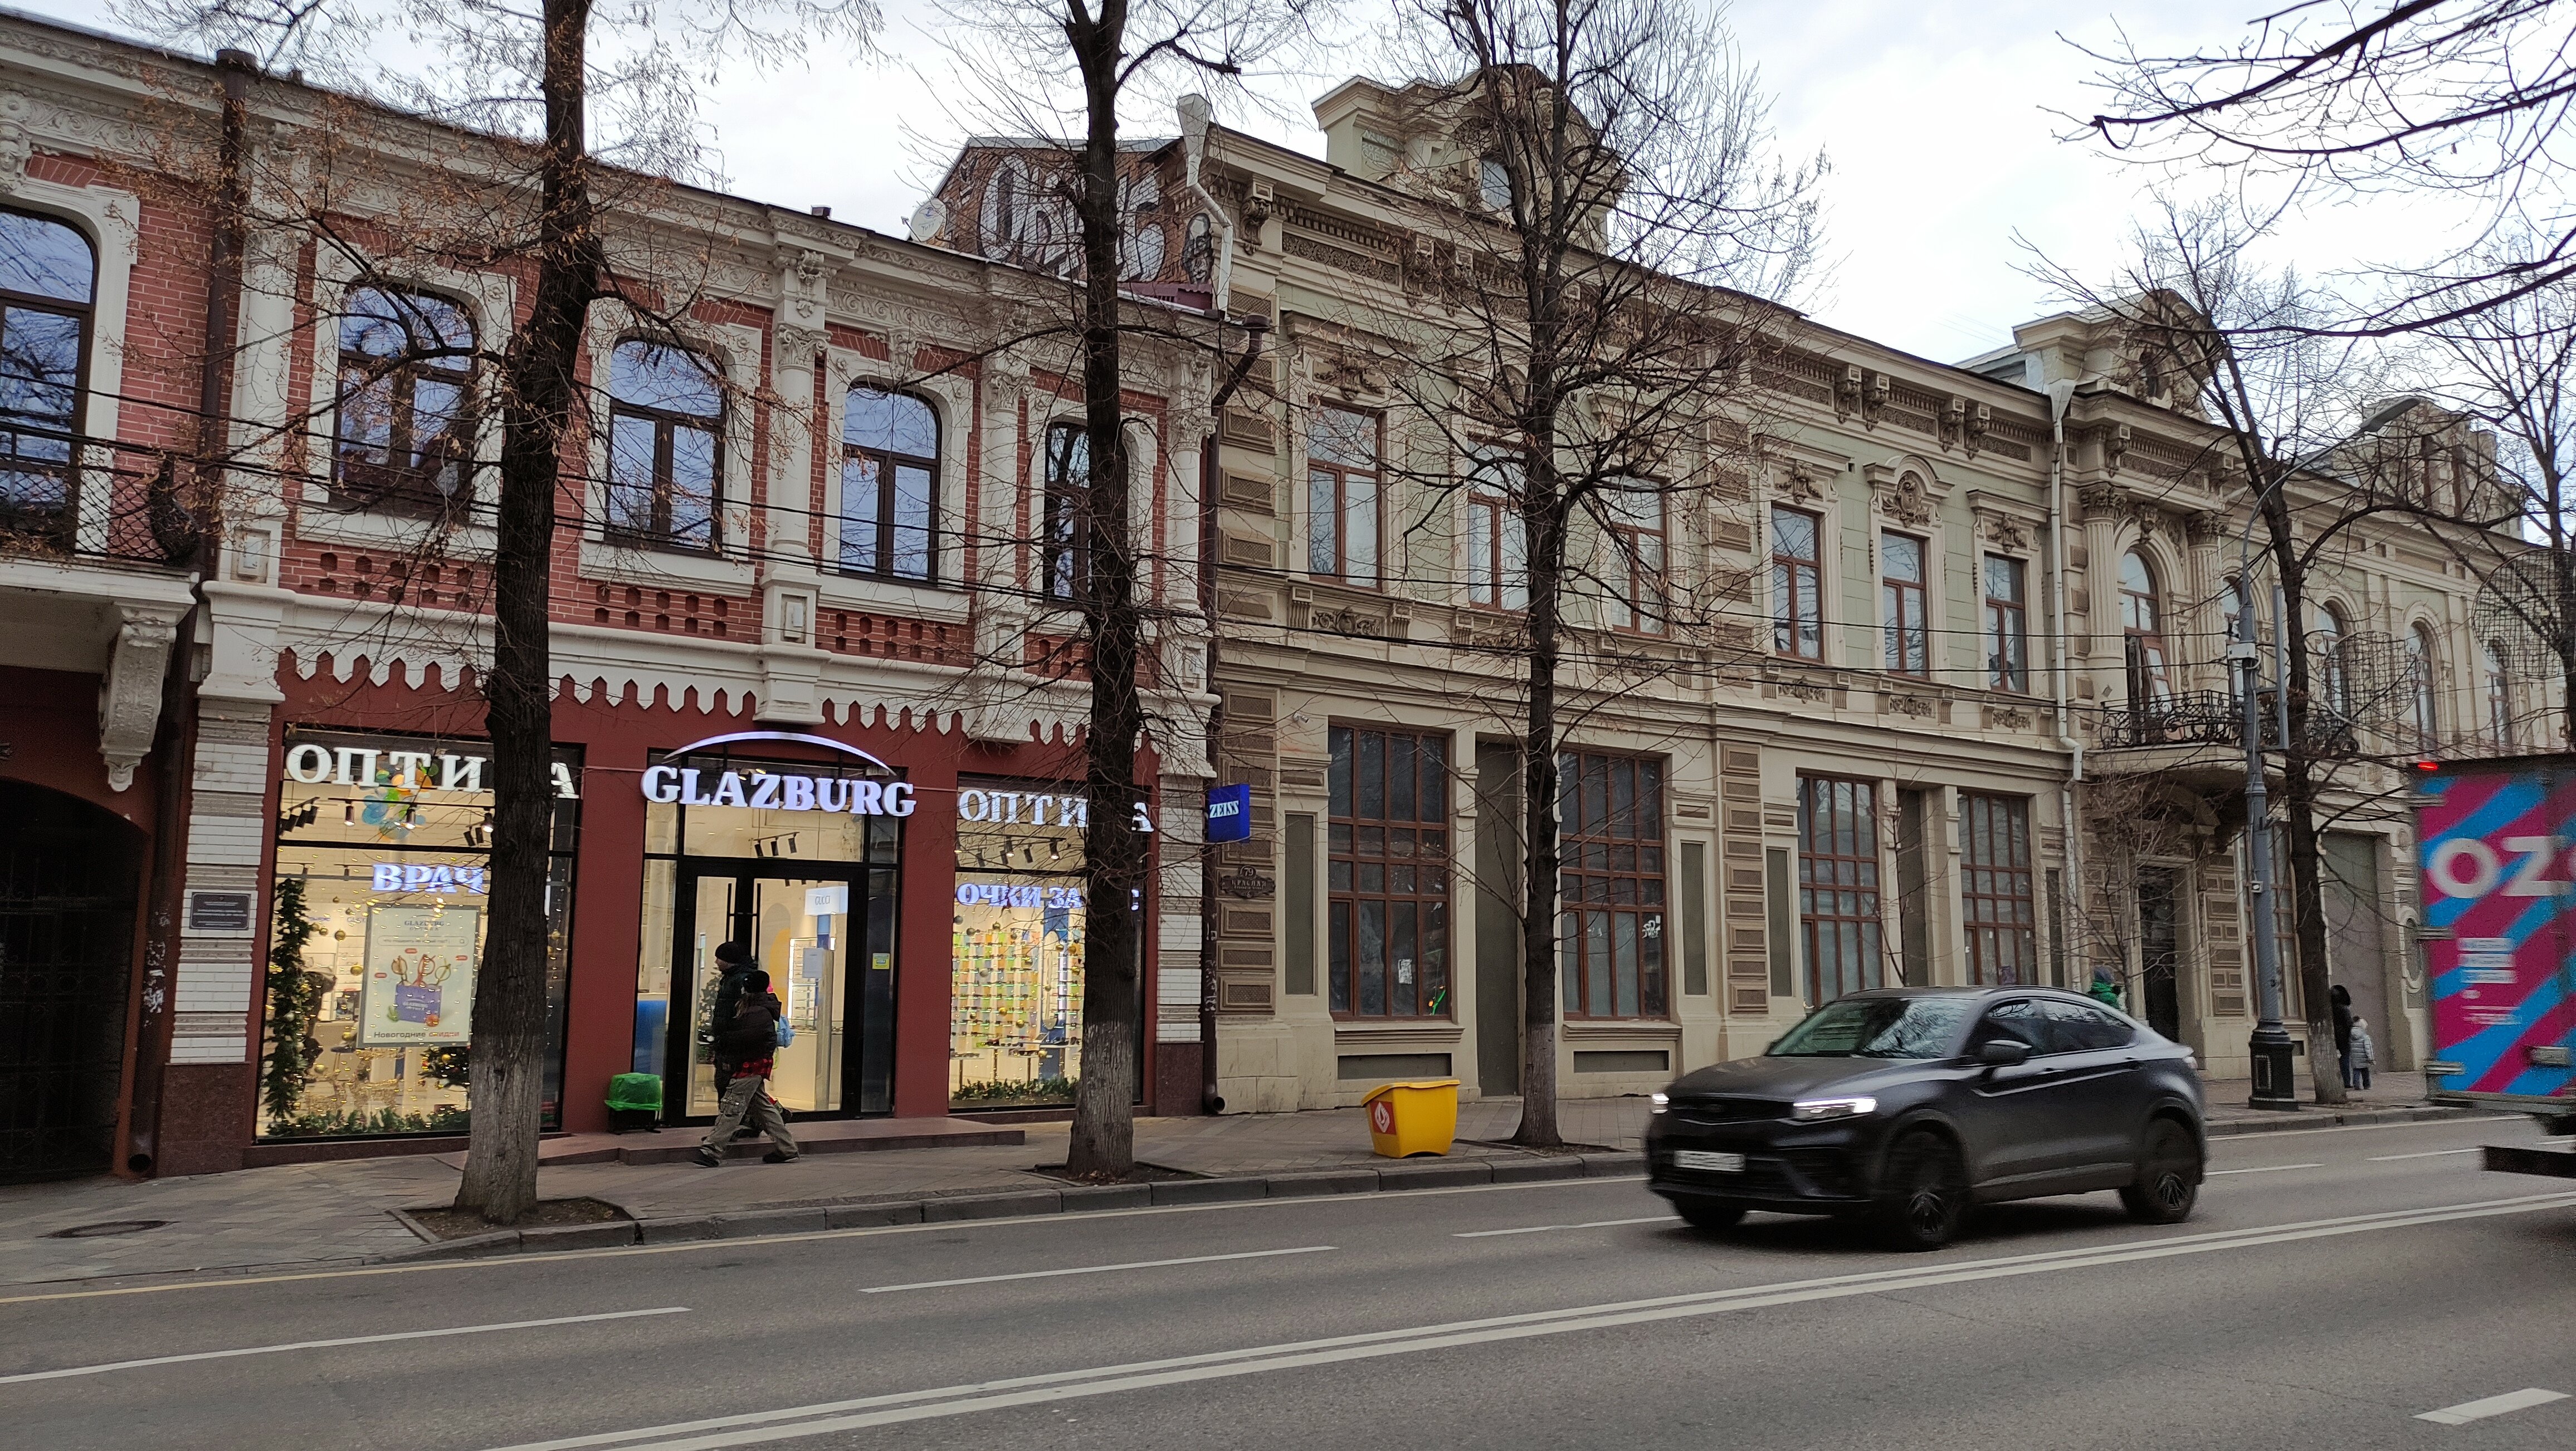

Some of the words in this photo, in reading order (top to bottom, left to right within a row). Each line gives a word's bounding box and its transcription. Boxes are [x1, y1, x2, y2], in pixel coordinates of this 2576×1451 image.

[286, 744, 579, 798] ОПТИА
[640, 765, 917, 817] GLAZBURG
[959, 790, 1154, 832] ОПТИА
[1209, 800, 1239, 819] ZEISS
[372, 864, 484, 894] ВРАЧ
[1243, 867, 1253, 877] 79
[2430, 835, 2576, 898] OZ
[815, 895, 830, 905] GUCCI
[956, 883, 1042, 908] ОЧКИ
[1047, 887, 1082, 909] ЗА
